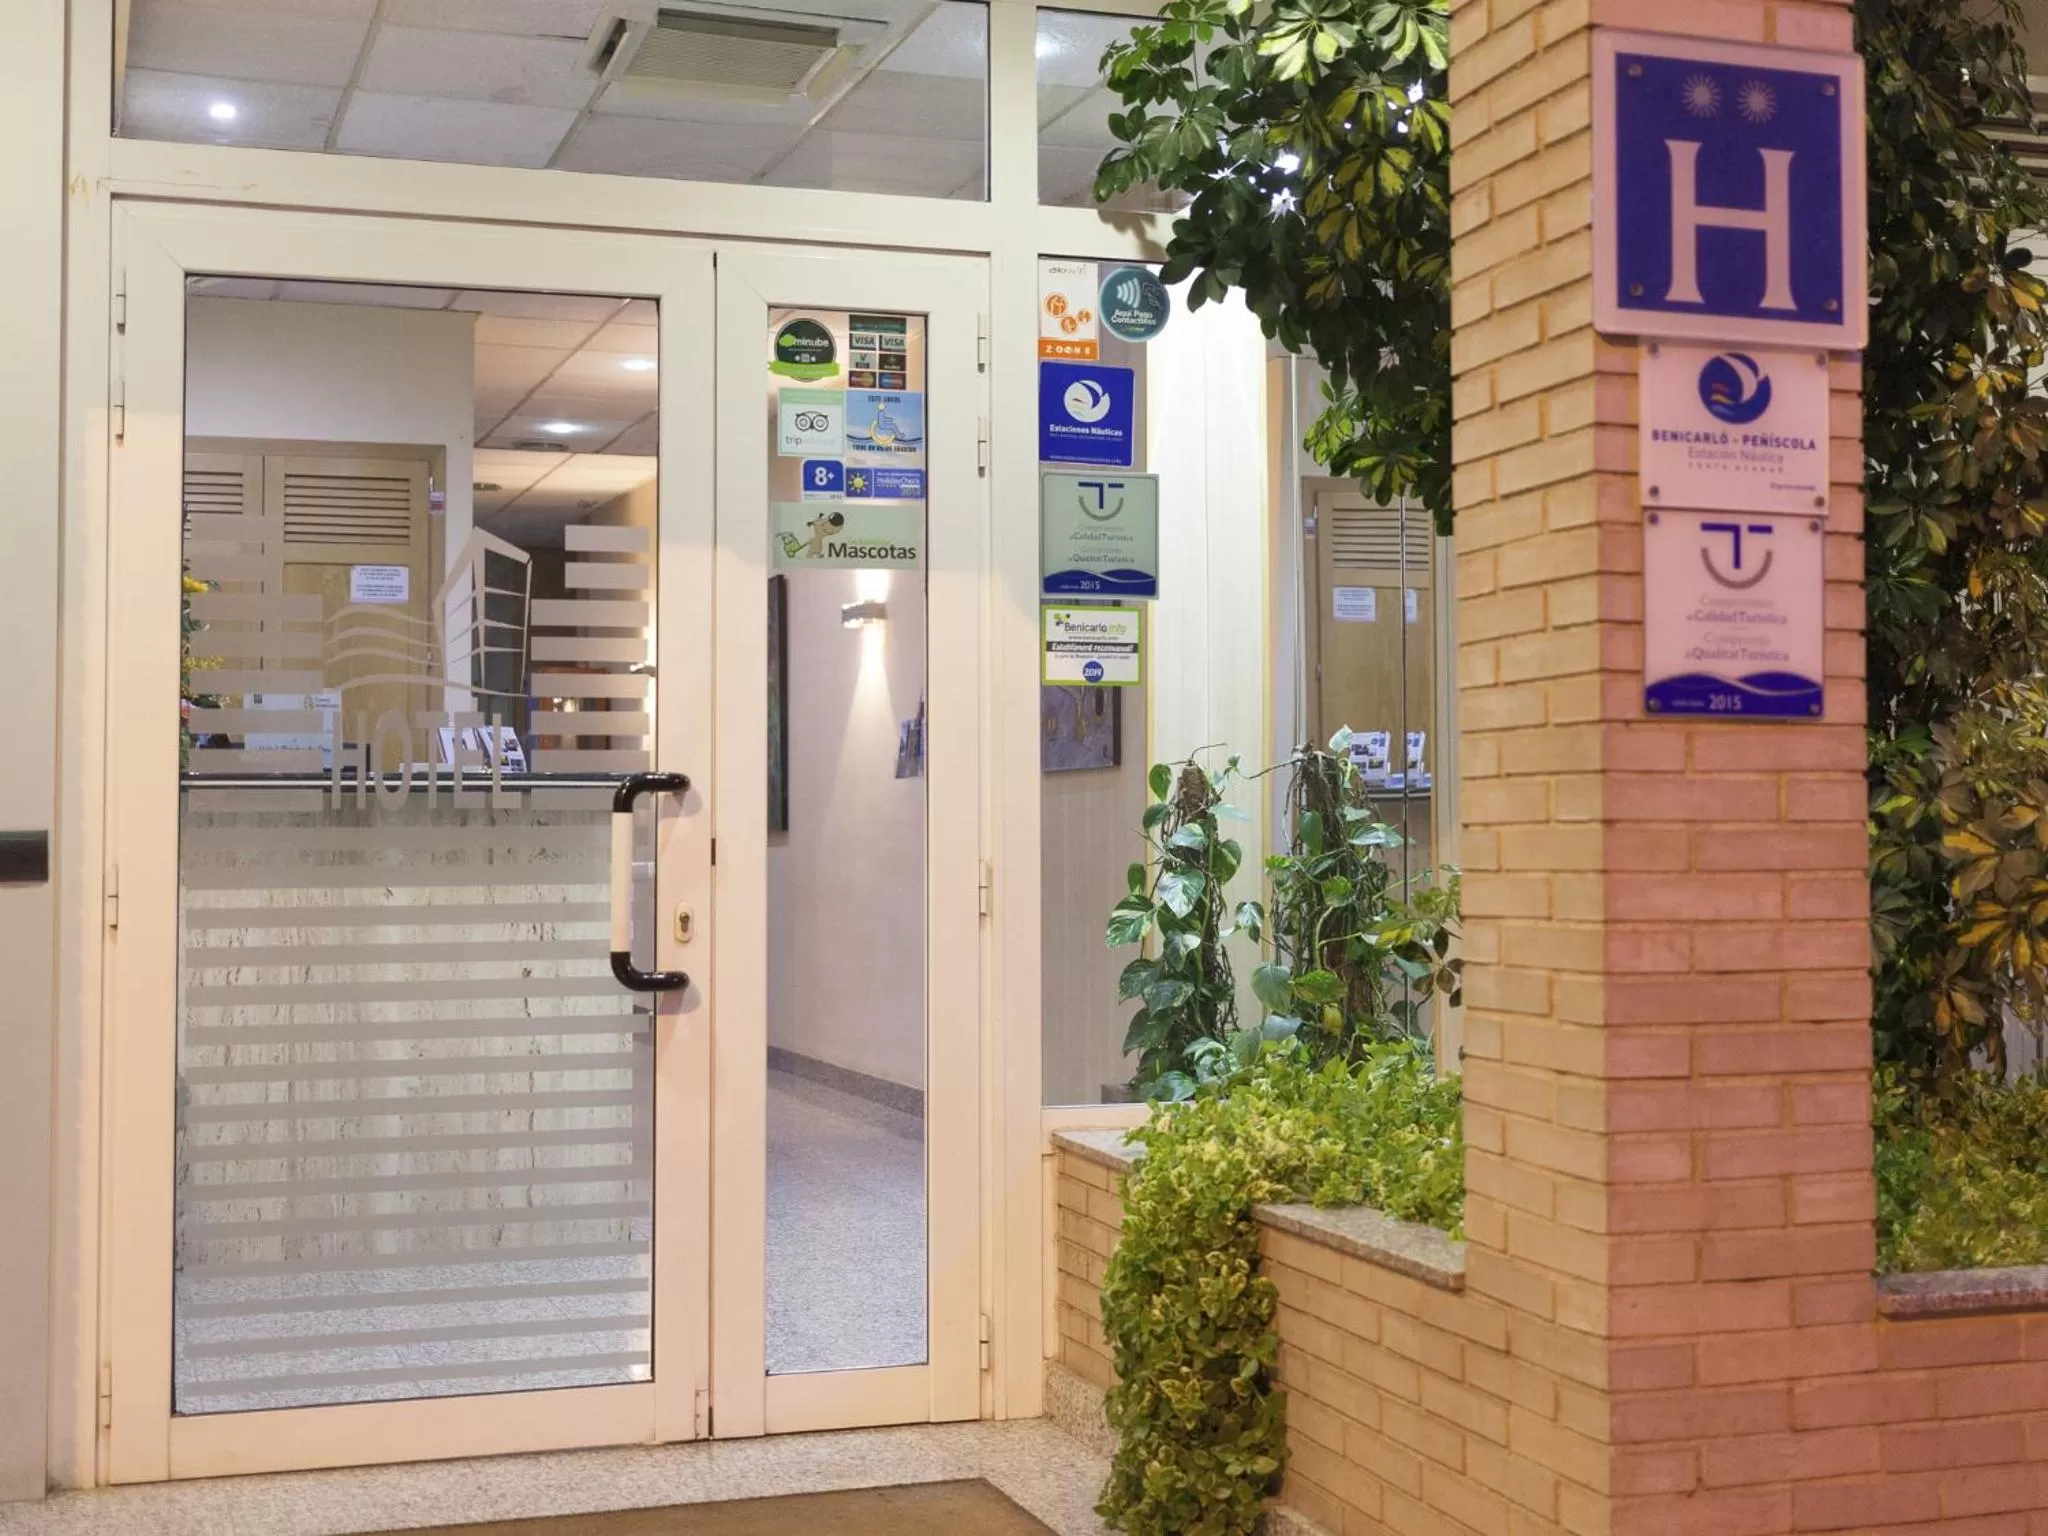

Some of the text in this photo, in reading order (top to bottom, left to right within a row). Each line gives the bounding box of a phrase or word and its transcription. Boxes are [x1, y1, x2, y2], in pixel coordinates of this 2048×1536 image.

[1664, 138, 1797, 310] H
[794, 336, 829, 347] minube
[854, 336, 905, 347] VISA VISA
[1049, 424, 1090, 435] Estaciones
[1091, 426, 1123, 437] Náuticas
[1652, 429, 1729, 445] BENICARLÓ
[1742, 432, 1816, 450] PEÑÍSCOLA
[828, 542, 916, 559] Mascotas
[1080, 581, 1100, 590] 2015
[1709, 694, 1742, 711] 2015
[331, 711, 522, 810] HOTEL
